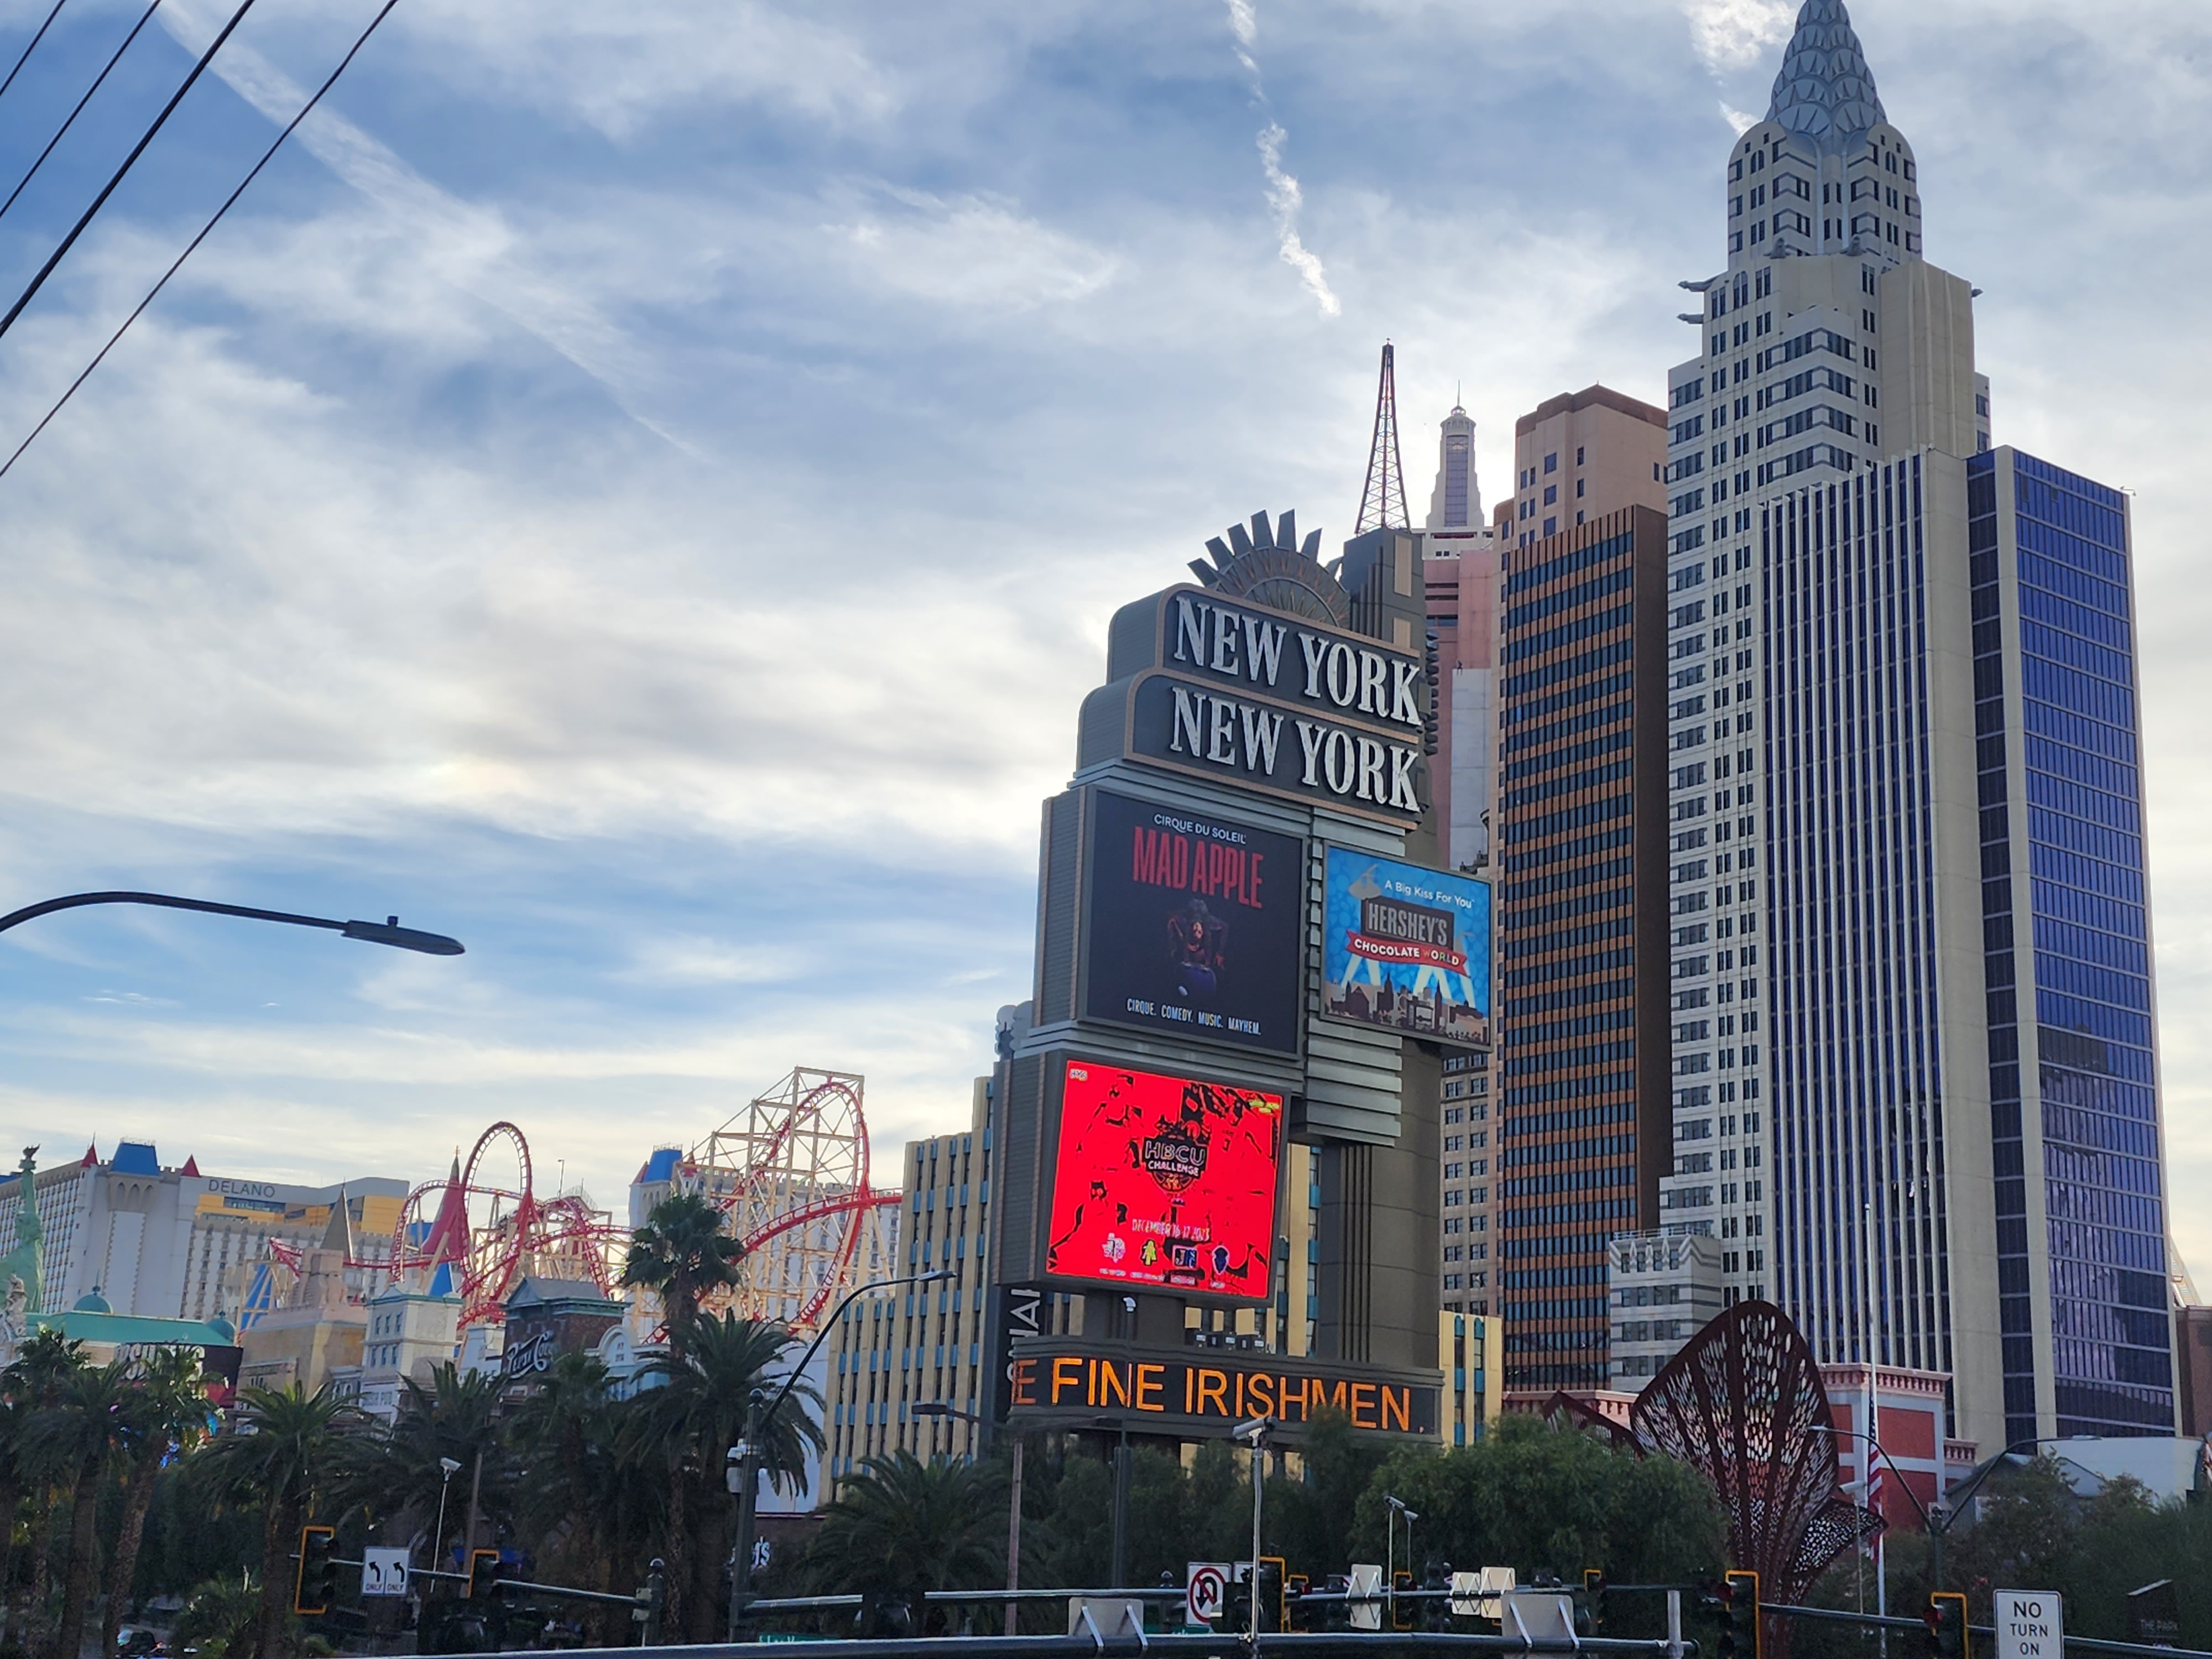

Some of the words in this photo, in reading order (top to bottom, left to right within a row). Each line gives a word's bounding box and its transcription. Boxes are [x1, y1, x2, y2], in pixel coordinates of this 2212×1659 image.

[1173, 596, 1287, 686] NEW
[1298, 632, 1422, 726] YORK
[1170, 686, 1284, 775] NEW
[1295, 719, 1420, 812] YORK
[1154, 813, 1193, 833] CIRQUE
[1195, 823, 1210, 836] DU
[1212, 827, 1246, 844] SOLEIL
[1133, 826, 1188, 889] MAD
[1191, 840, 1264, 908] APPLE
[1385, 880, 1392, 890] A
[1395, 881, 1411, 896] Big
[1414, 886, 1433, 900] Kiss
[1436, 891, 1452, 903] For
[1368, 902, 1448, 946] HERSHEY'S
[1354, 938, 1420, 958] CHOCOLATE
[1423, 950, 1459, 966] WORLD
[1127, 998, 1156, 1016] CIRQUE.
[1161, 1004, 1193, 1023] COMEDY.
[1198, 1011, 1223, 1028] MUSIC.
[1228, 1016, 1261, 1035] MAYHEM.
[1145, 1140, 1206, 1166] HBCU
[1147, 1160, 1199, 1176] CHALLENGE
[208, 1179, 275, 1198] DELANO
[1052, 1357, 1165, 1411] FINE
[387, 1583, 404, 1592] ONLY
[2013, 1600, 2042, 1618] NO
[2009, 1623, 2048, 1637] TURN
[2019, 1641, 2039, 1656] ON
